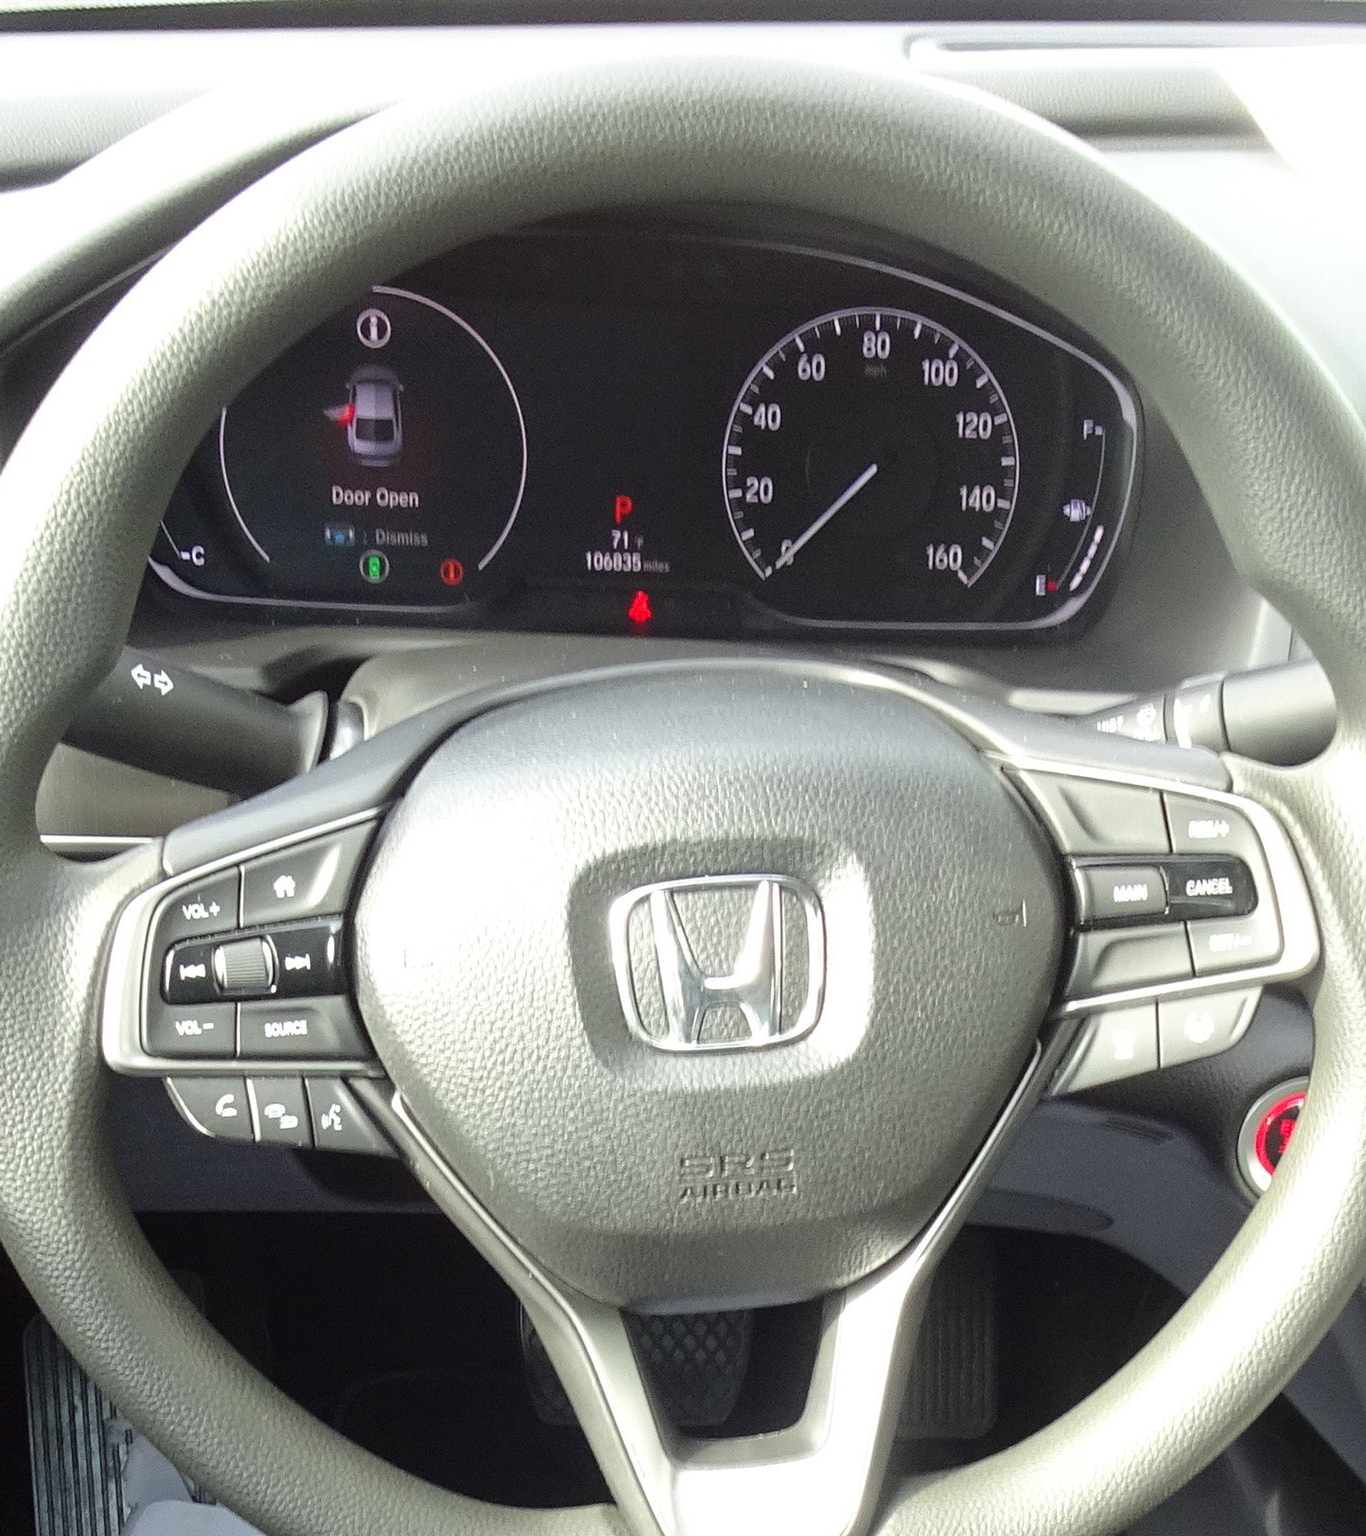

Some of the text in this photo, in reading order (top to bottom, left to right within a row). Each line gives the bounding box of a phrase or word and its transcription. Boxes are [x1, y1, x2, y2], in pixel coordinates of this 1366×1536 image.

[862, 331, 891, 359] 80
[797, 354, 826, 381] 60
[921, 358, 958, 387] 100
[753, 404, 782, 431] 40
[956, 412, 993, 440] 120
[1083, 419, 1094, 440] F
[331, 485, 420, 509] Door Open
[745, 478, 774, 504] 20
[959, 485, 996, 512] 140
[616, 495, 633, 525] P
[375, 527, 428, 547] Dismiss
[611, 529, 629, 550] 71
[191, 545, 205, 566] C
[926, 545, 964, 571] 160
[1113, 884, 1148, 902] MAIN
[1186, 877, 1233, 896] CANCEL
[264, 1020, 308, 1038] SOURCE
[679, 1149, 795, 1178] SRS
